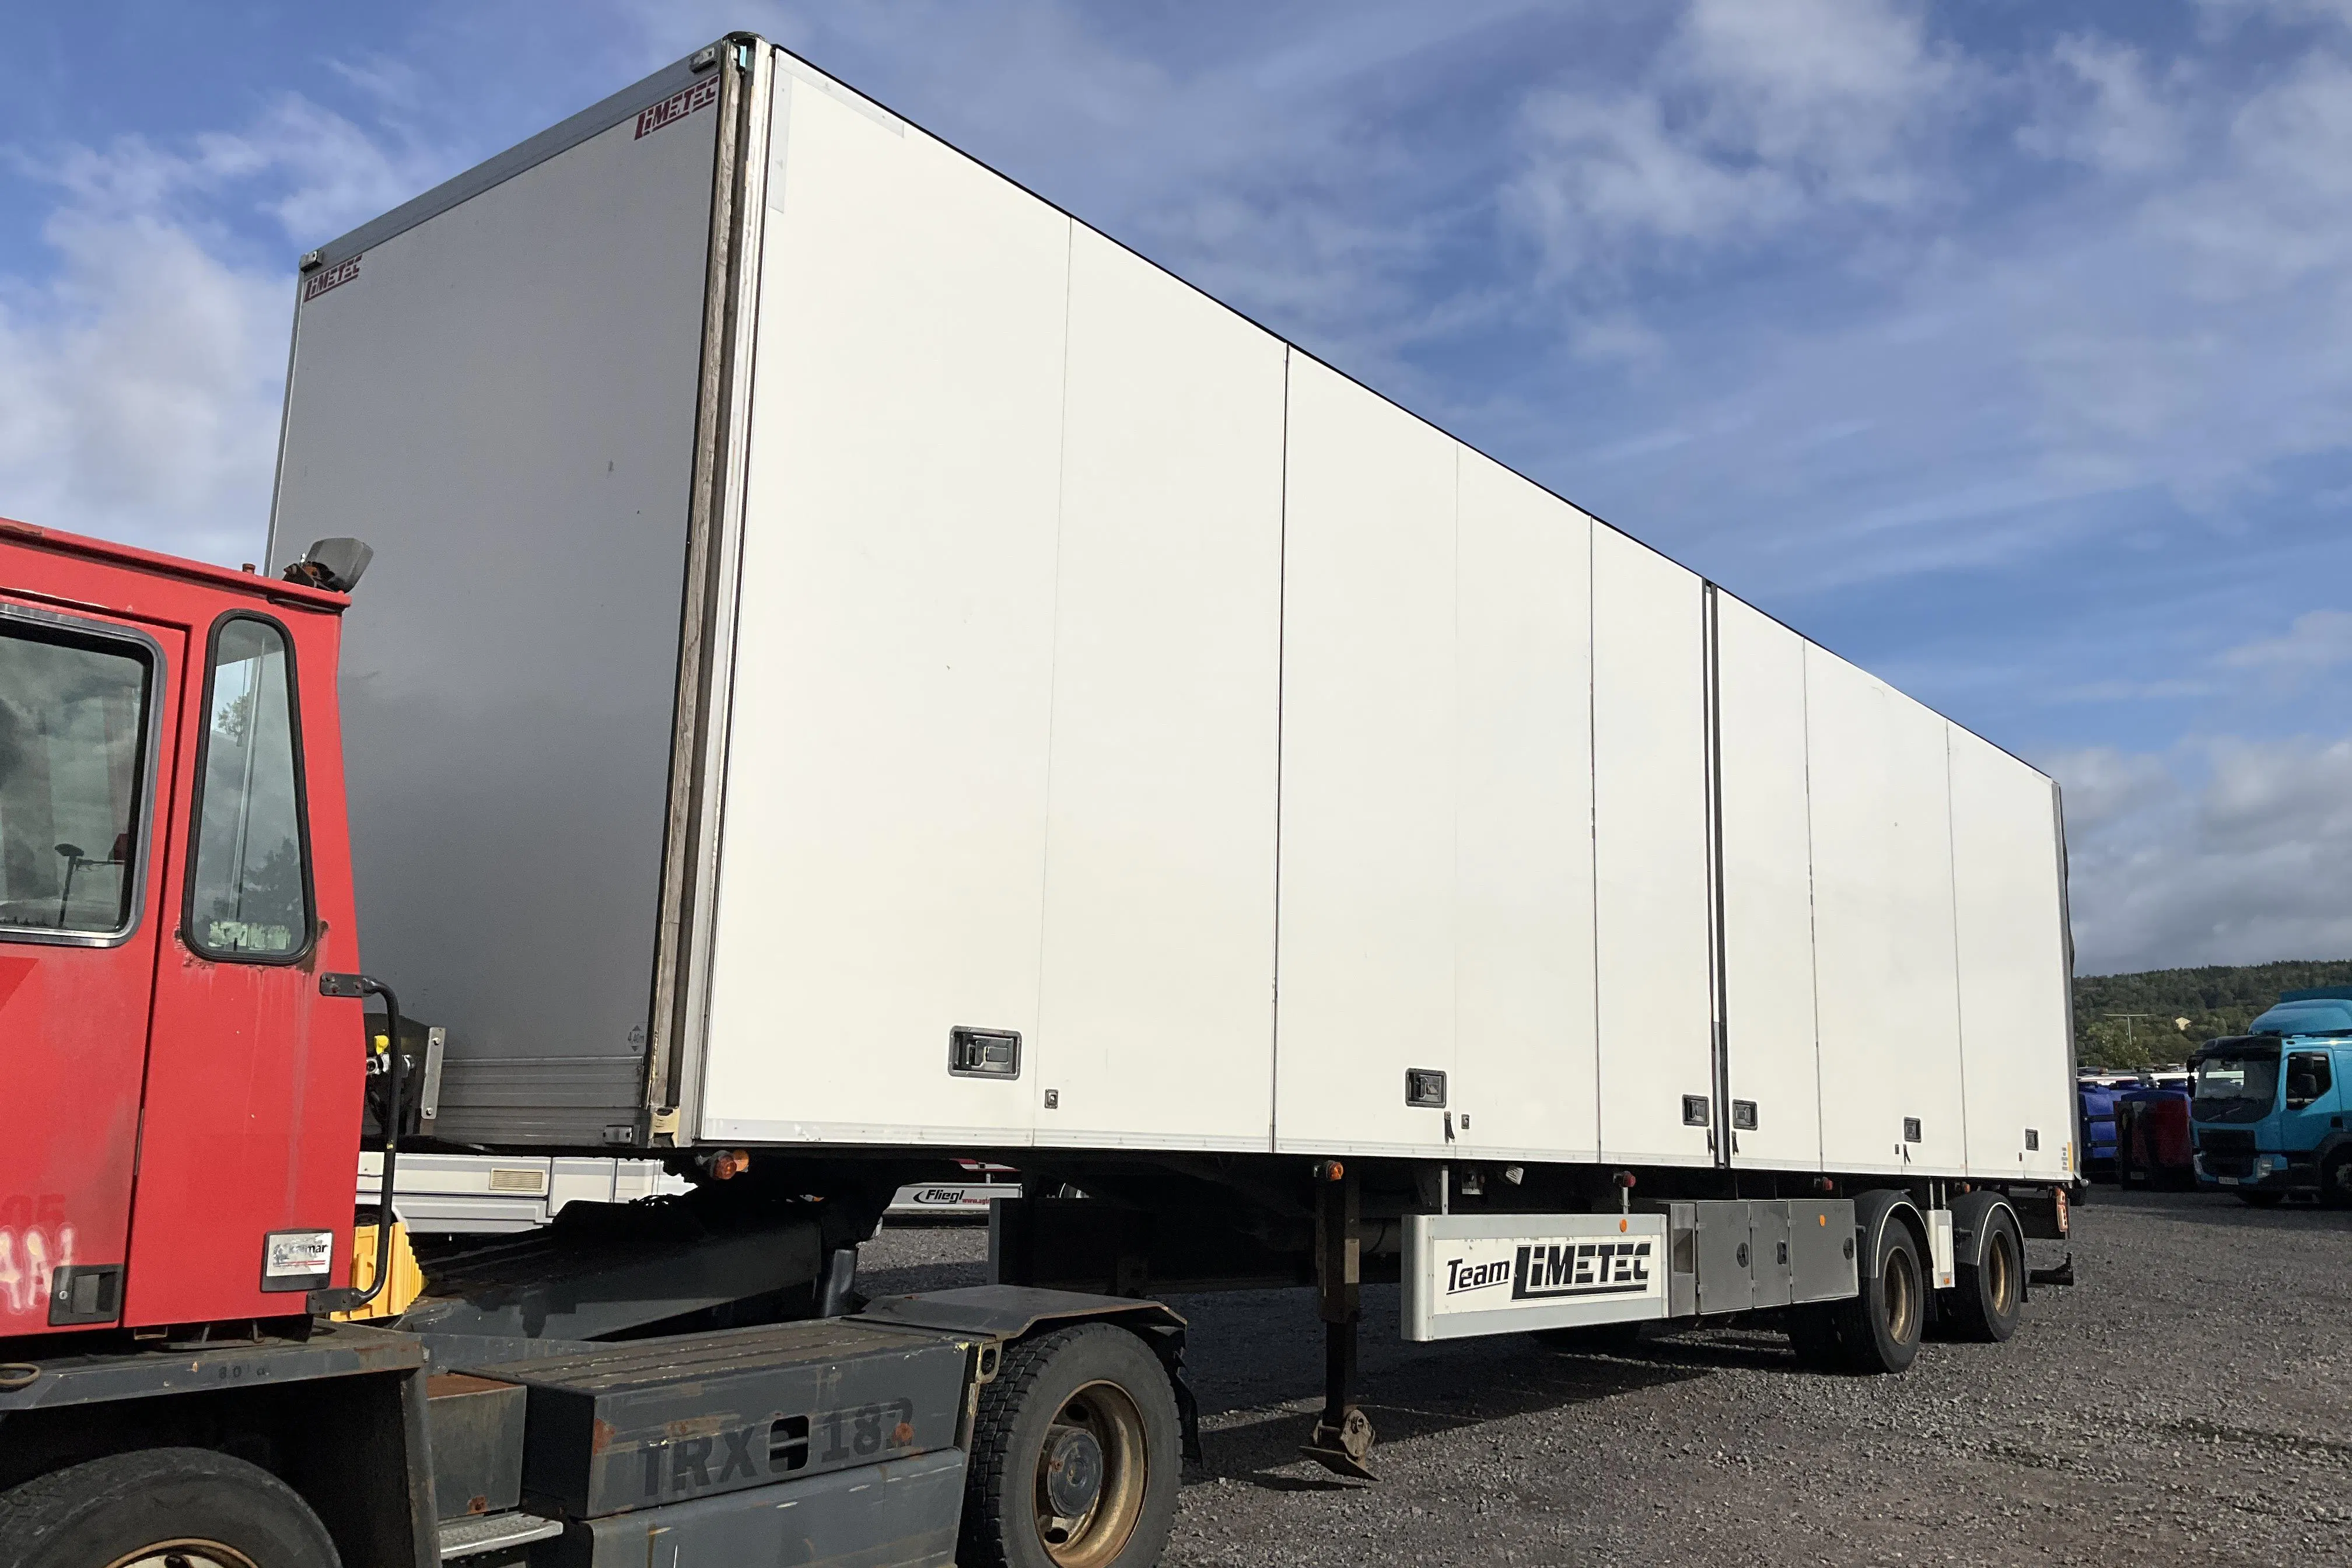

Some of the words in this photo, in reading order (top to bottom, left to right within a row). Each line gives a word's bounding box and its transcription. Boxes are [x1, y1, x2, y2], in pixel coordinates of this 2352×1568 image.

[925, 1189, 965, 1203] Fliegl
[1447, 1258, 1510, 1292] Team
[637, 1427, 758, 1497] TRX
